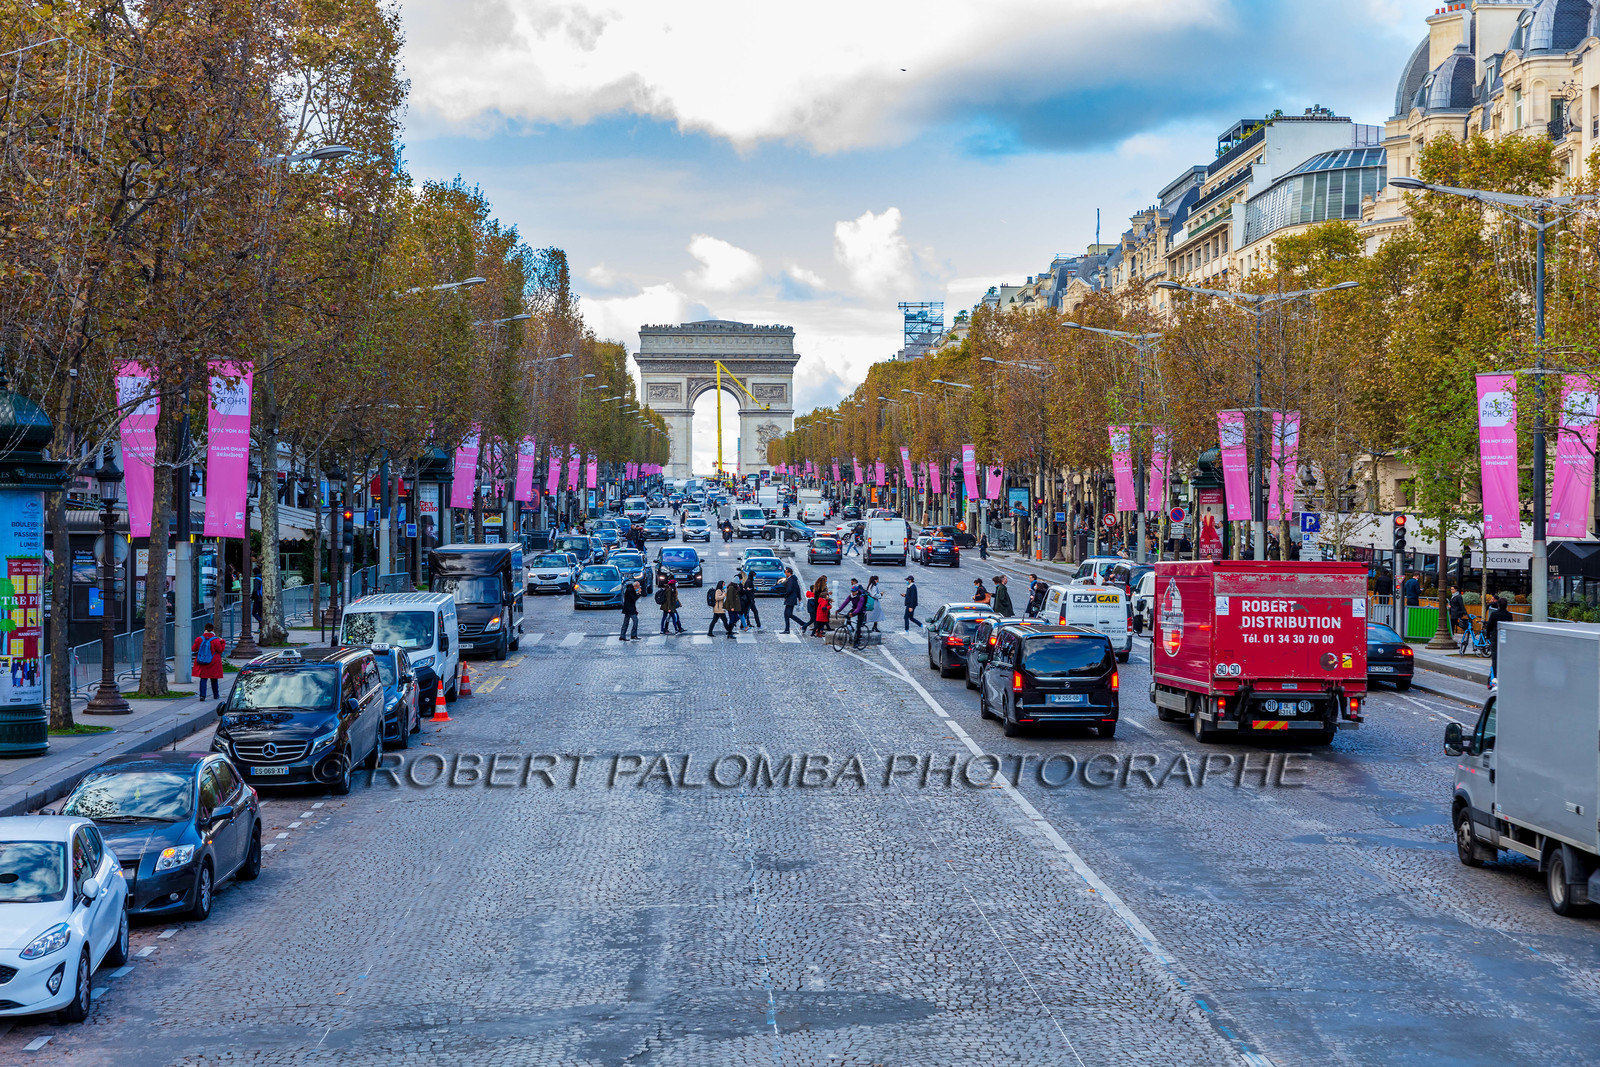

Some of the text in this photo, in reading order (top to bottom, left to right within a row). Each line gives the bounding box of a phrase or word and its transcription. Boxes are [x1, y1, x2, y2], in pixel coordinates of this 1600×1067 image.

[1, 596, 26, 605] TRE
[1242, 600, 1297, 612] ROBERT
[1242, 616, 1341, 628] DISTRIBUTION
[1242, 634, 1334, 643] Tél. 01 34 30 70 00
[1218, 665, 1226, 674] 80
[1230, 665, 1240, 674] 90
[1267, 701, 1275, 710] 80
[1301, 701, 1308, 710] 90
[255, 766, 285, 774] ES-069-XY
